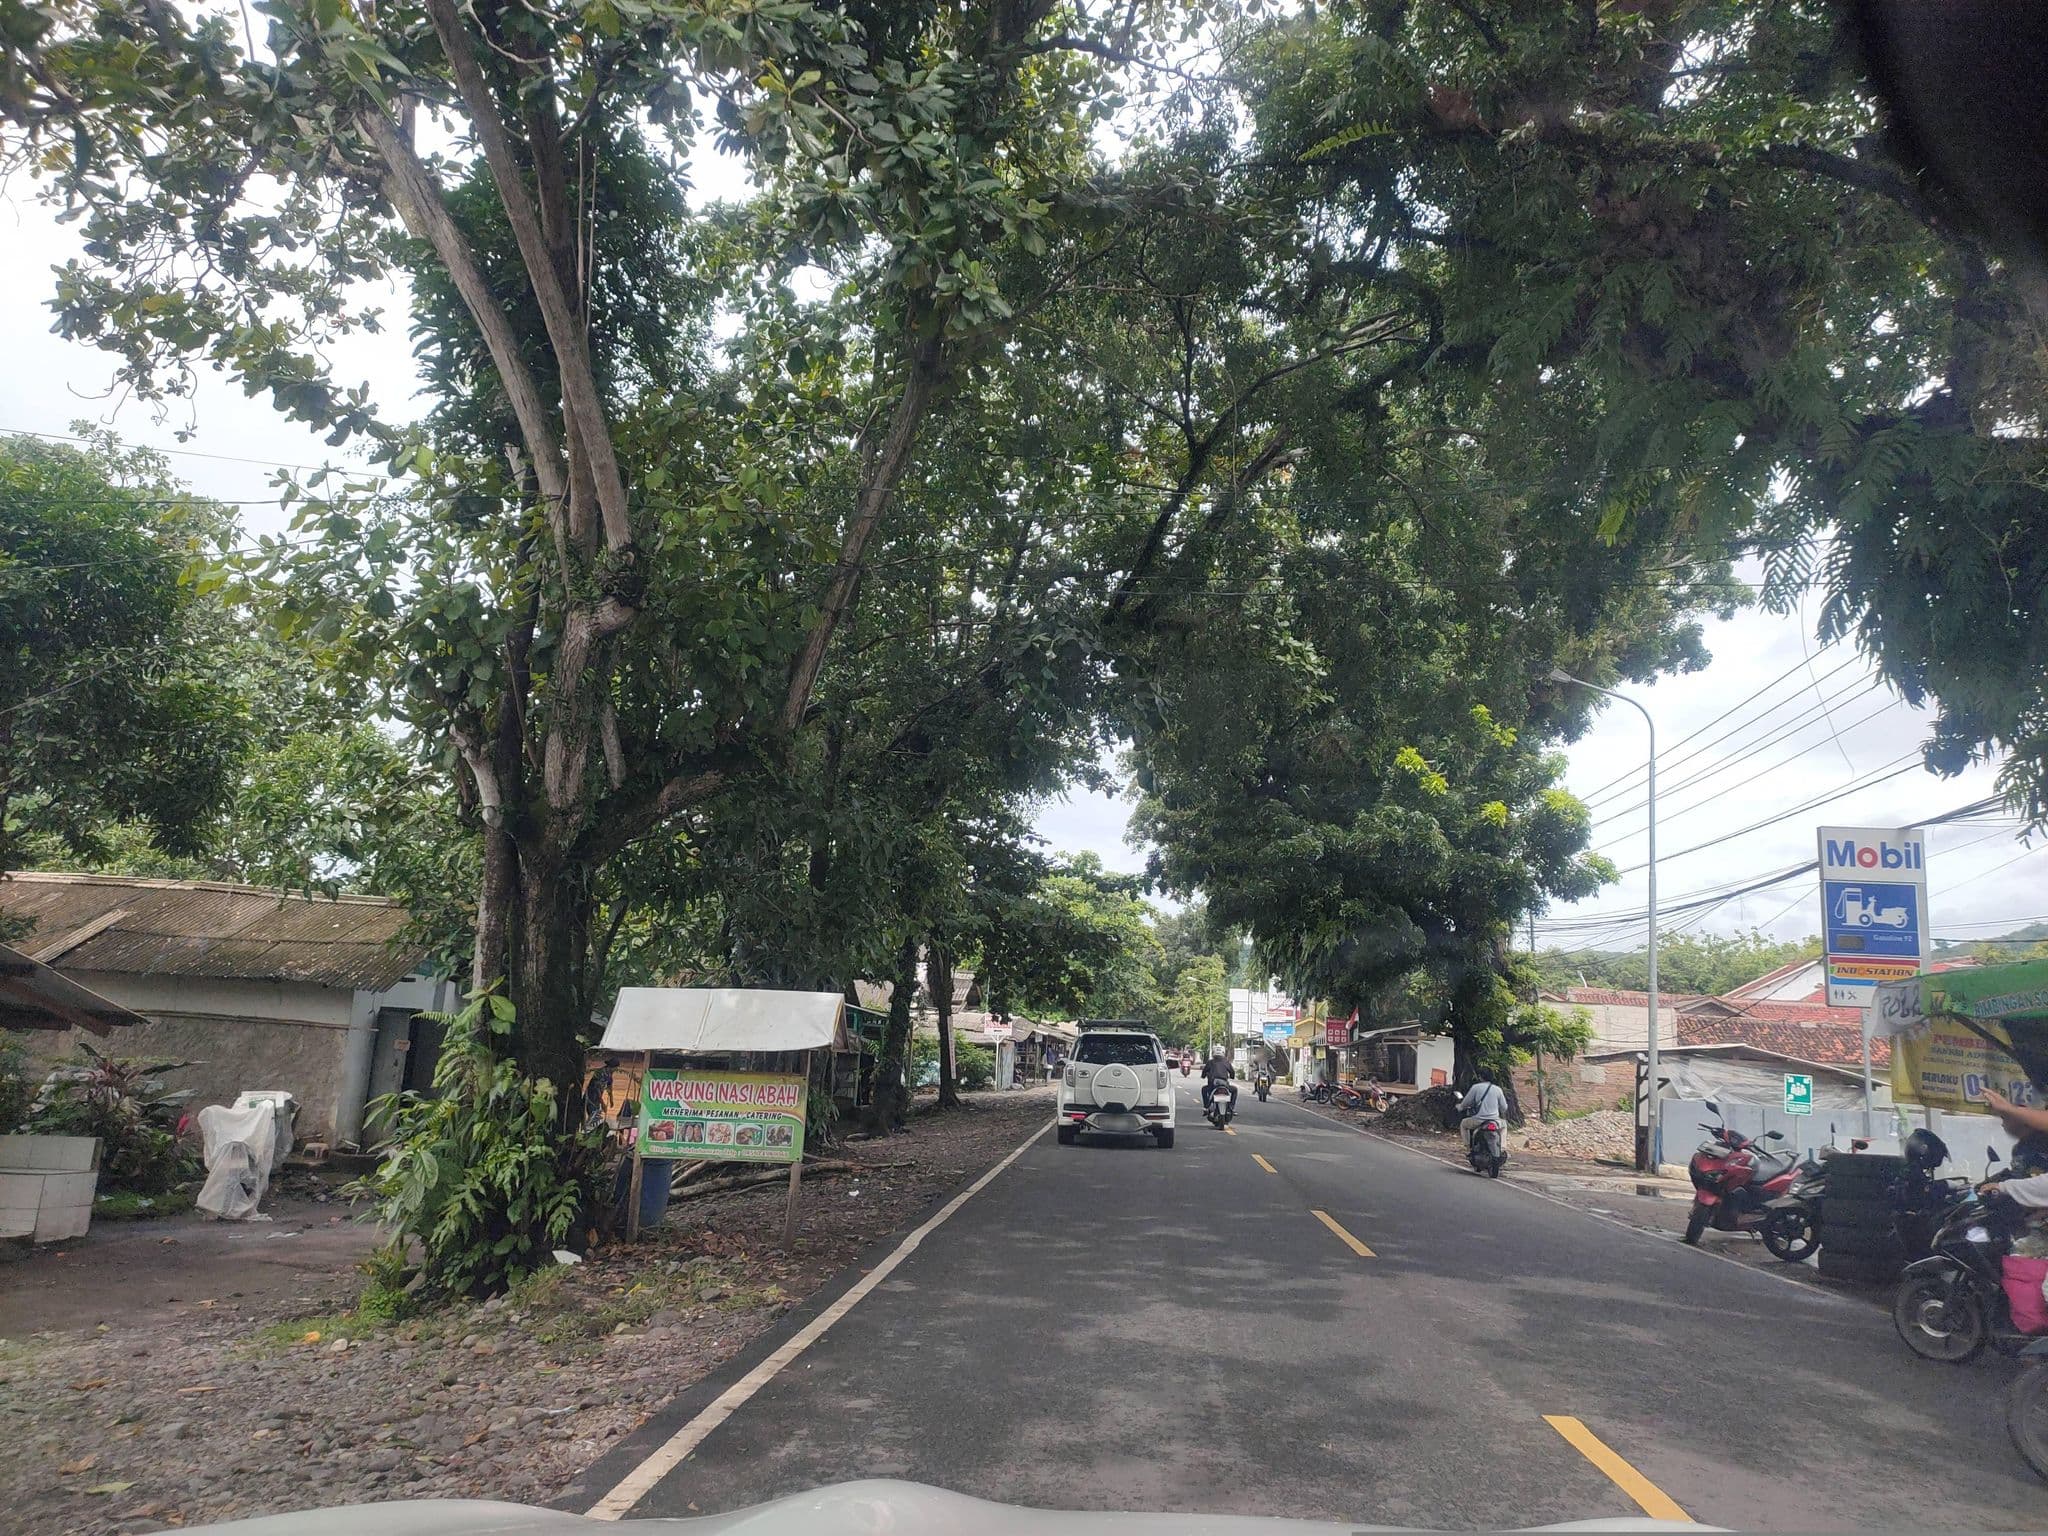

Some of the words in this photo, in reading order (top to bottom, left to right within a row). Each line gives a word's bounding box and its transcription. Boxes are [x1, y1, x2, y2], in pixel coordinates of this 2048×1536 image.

[1826, 839, 1921, 869] Mobil
[650, 1079, 715, 1103] WARUNG
[717, 1082, 754, 1104] NASI
[755, 1083, 800, 1106] ABAH
[662, 1107, 703, 1117] MENERIMA
[706, 1110, 740, 1118] PESANAN
